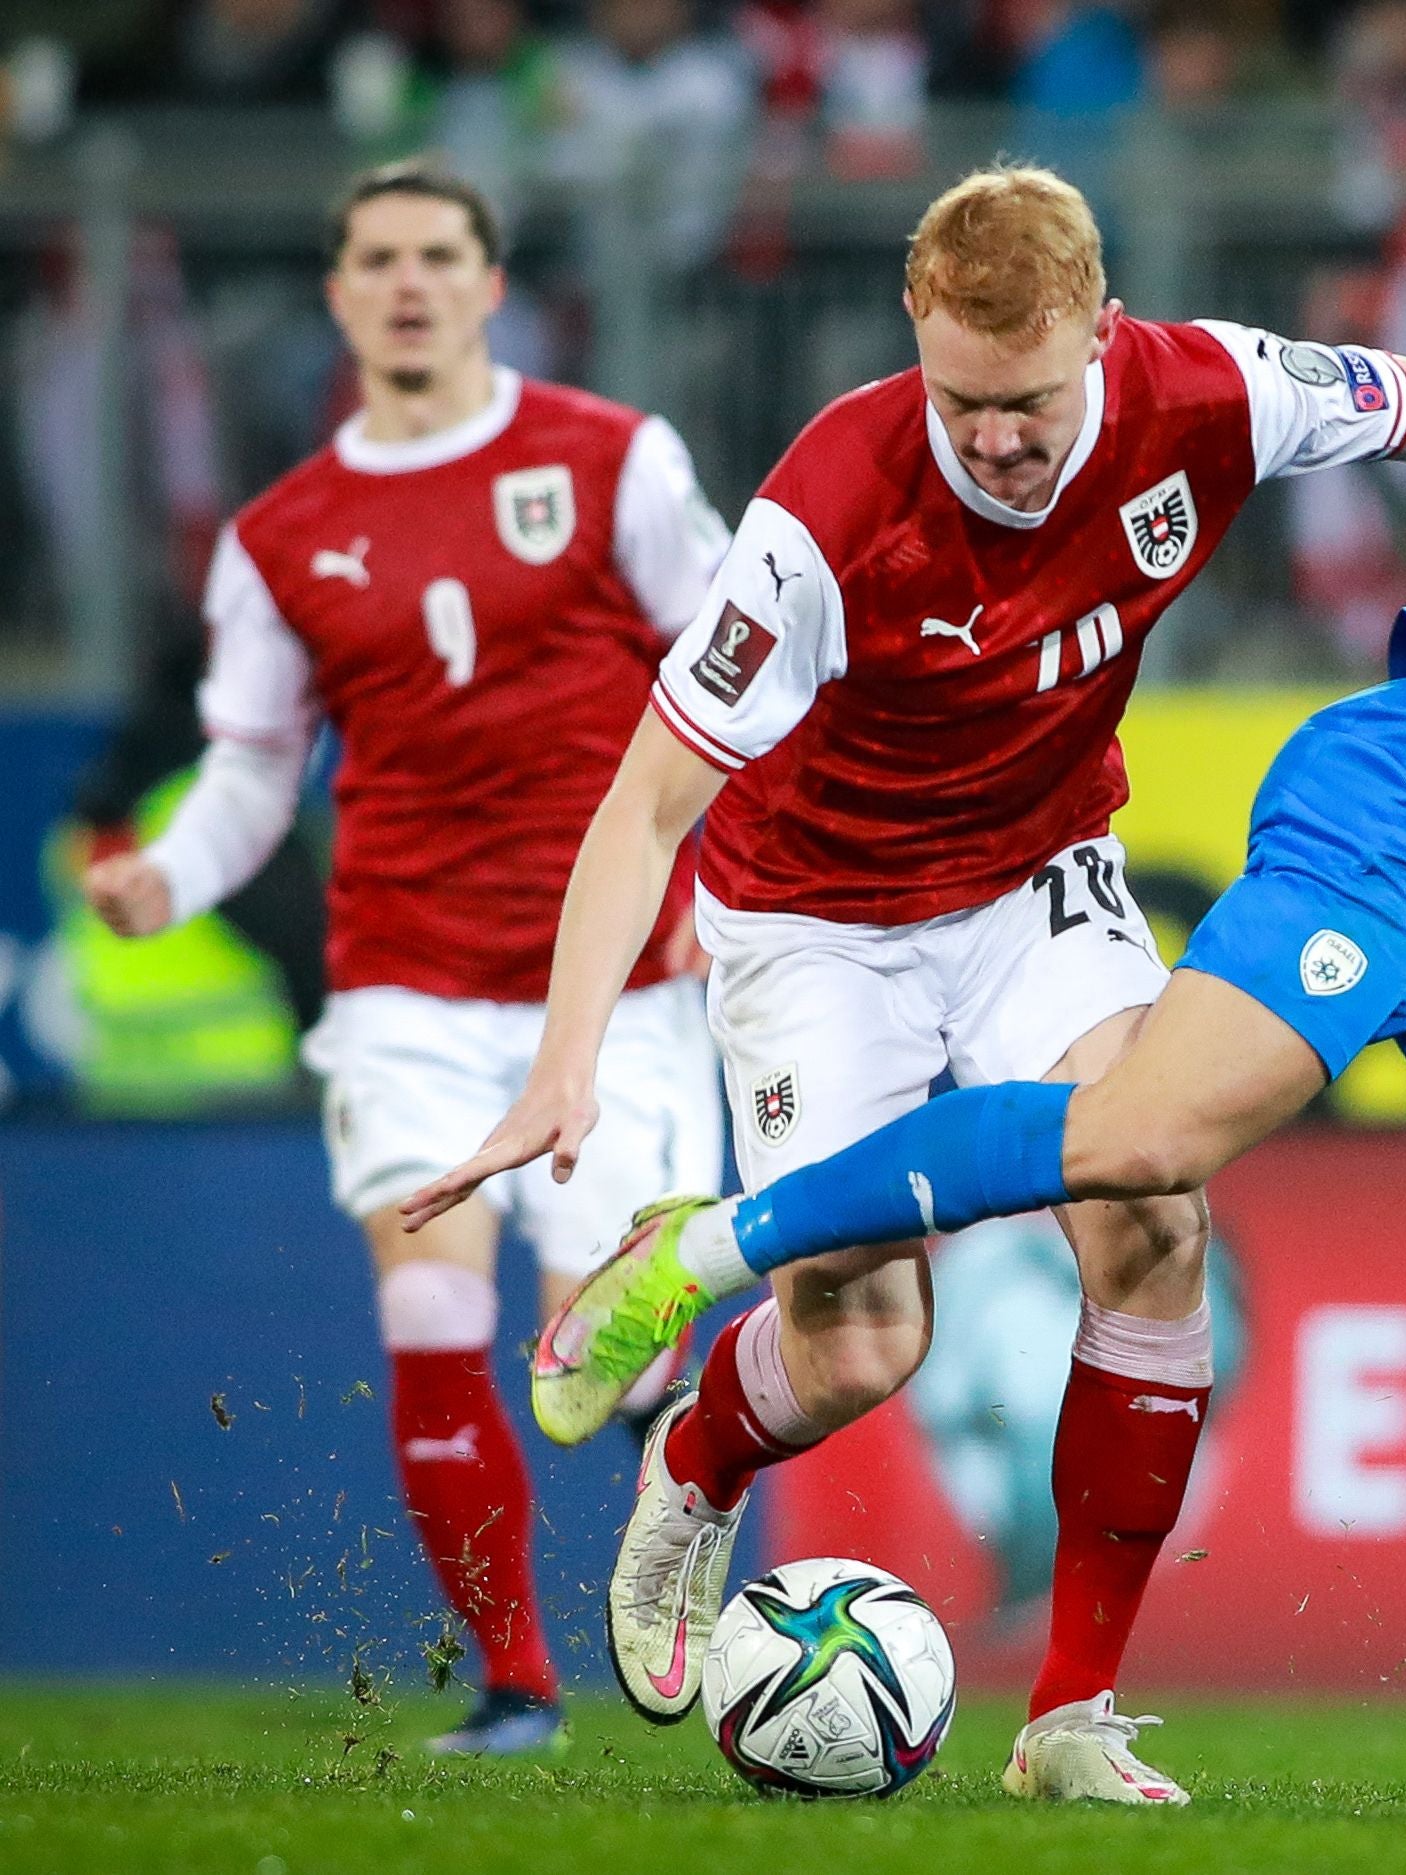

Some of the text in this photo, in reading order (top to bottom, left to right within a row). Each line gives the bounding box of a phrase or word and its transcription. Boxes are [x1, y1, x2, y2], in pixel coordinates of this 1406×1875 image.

[1344, 350, 1373, 384] RES
[421, 576, 478, 688] 9
[1032, 845, 1126, 938] 20
